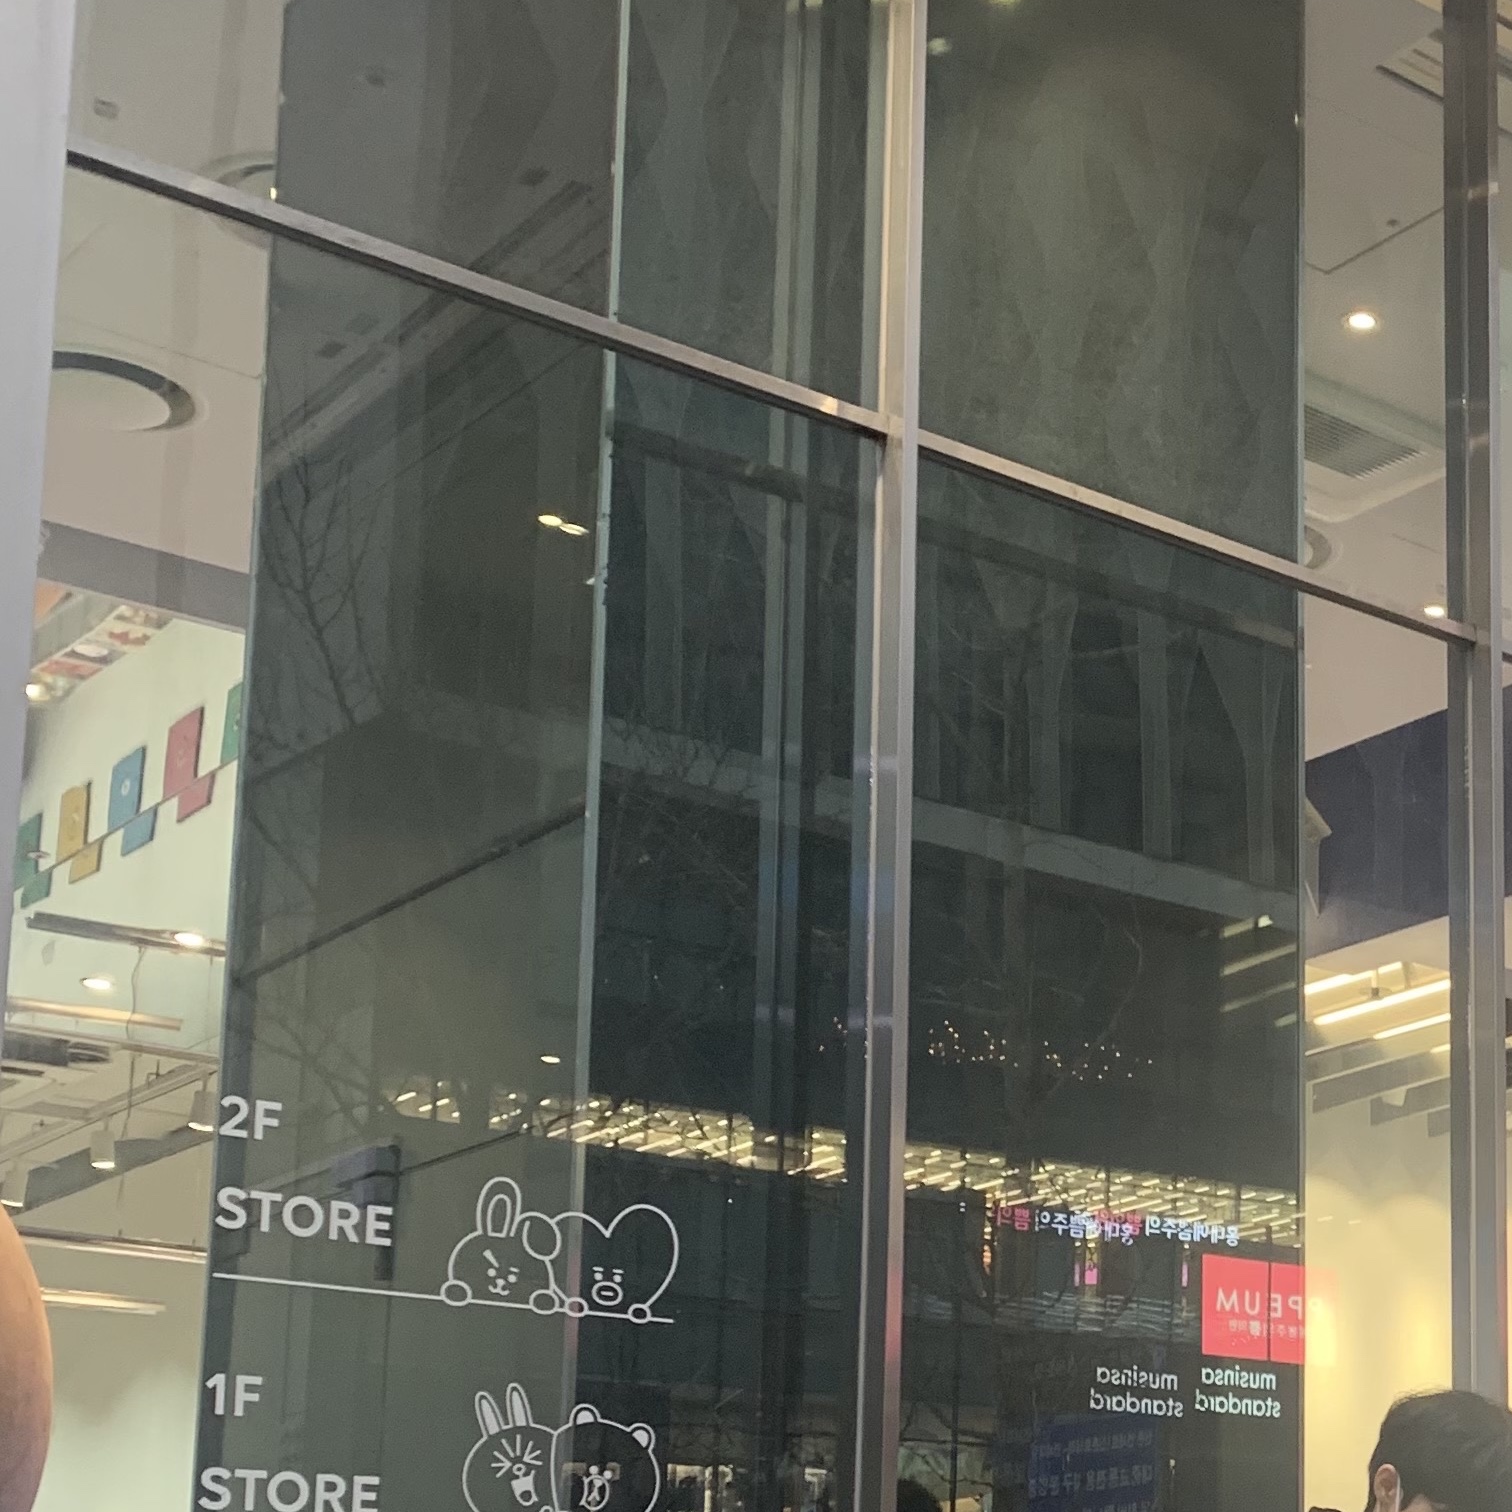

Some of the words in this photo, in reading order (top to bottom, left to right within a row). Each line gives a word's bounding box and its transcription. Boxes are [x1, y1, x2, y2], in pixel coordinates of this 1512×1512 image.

[219, 1096, 283, 1140] 2F
[215, 1186, 393, 1246] STORE
[205, 1374, 263, 1417] 1F
